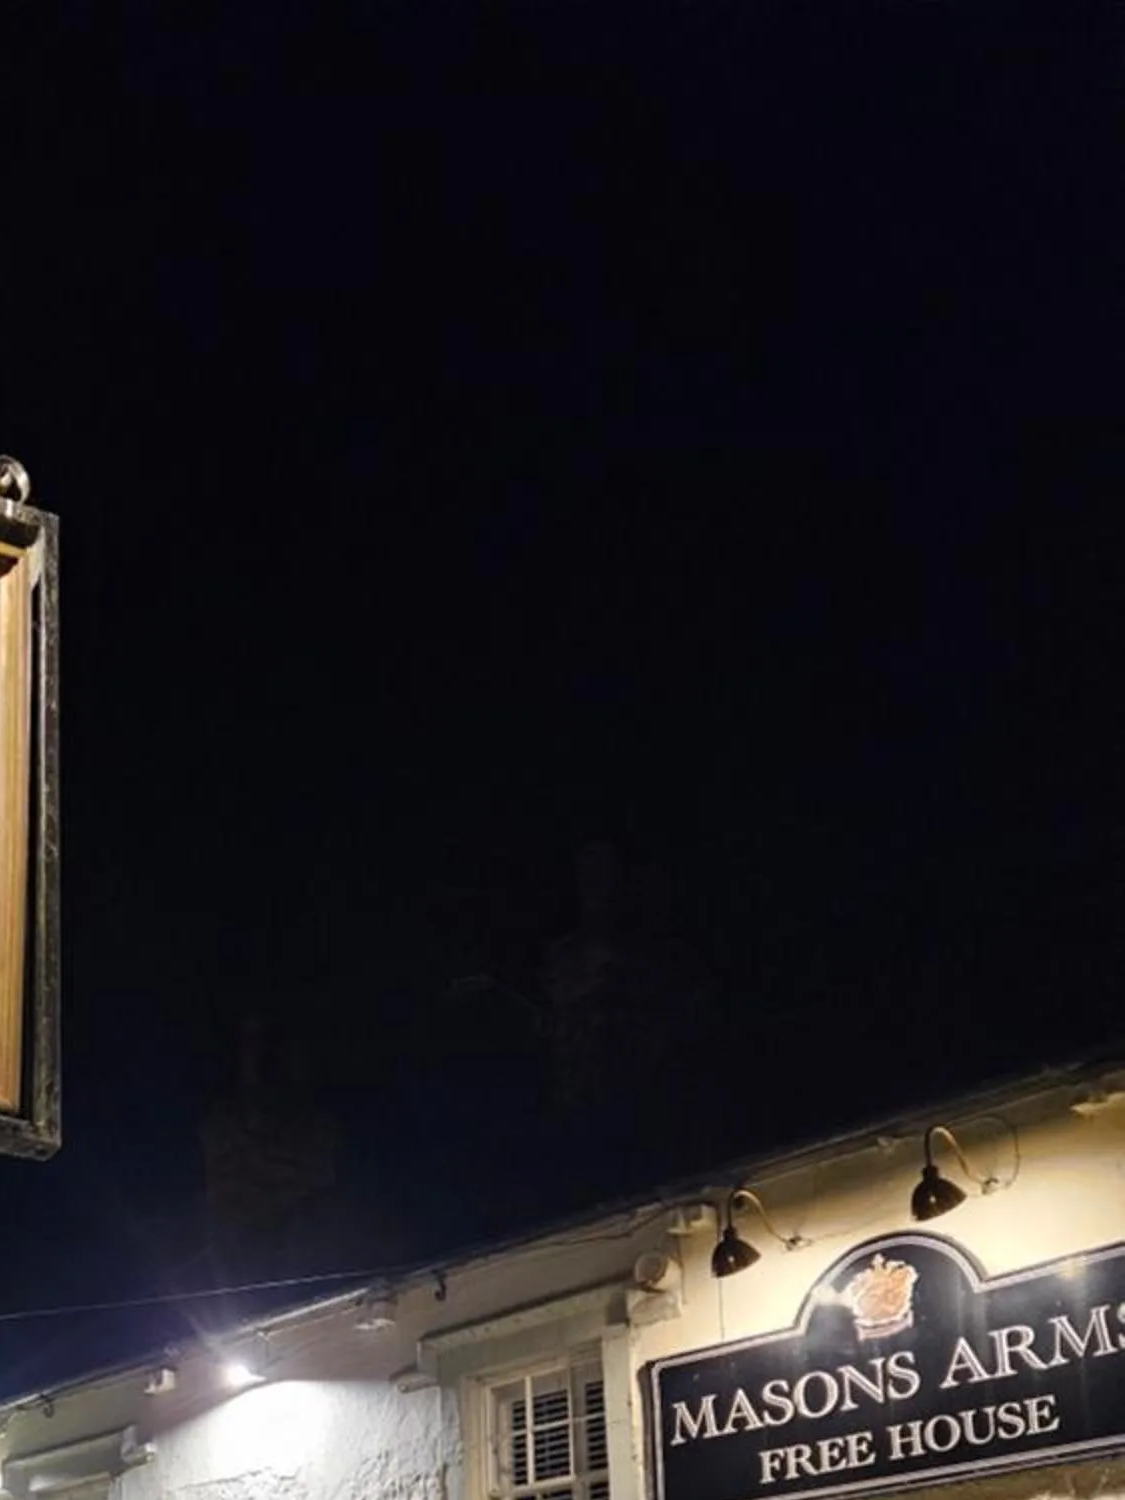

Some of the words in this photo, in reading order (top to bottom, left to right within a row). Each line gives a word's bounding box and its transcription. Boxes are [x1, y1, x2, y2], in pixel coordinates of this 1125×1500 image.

[670, 1349, 921, 1447] MASONS
[939, 1301, 1125, 1390] ARM
[758, 1430, 876, 1484] FREE
[885, 1394, 1061, 1461] HOUSE
